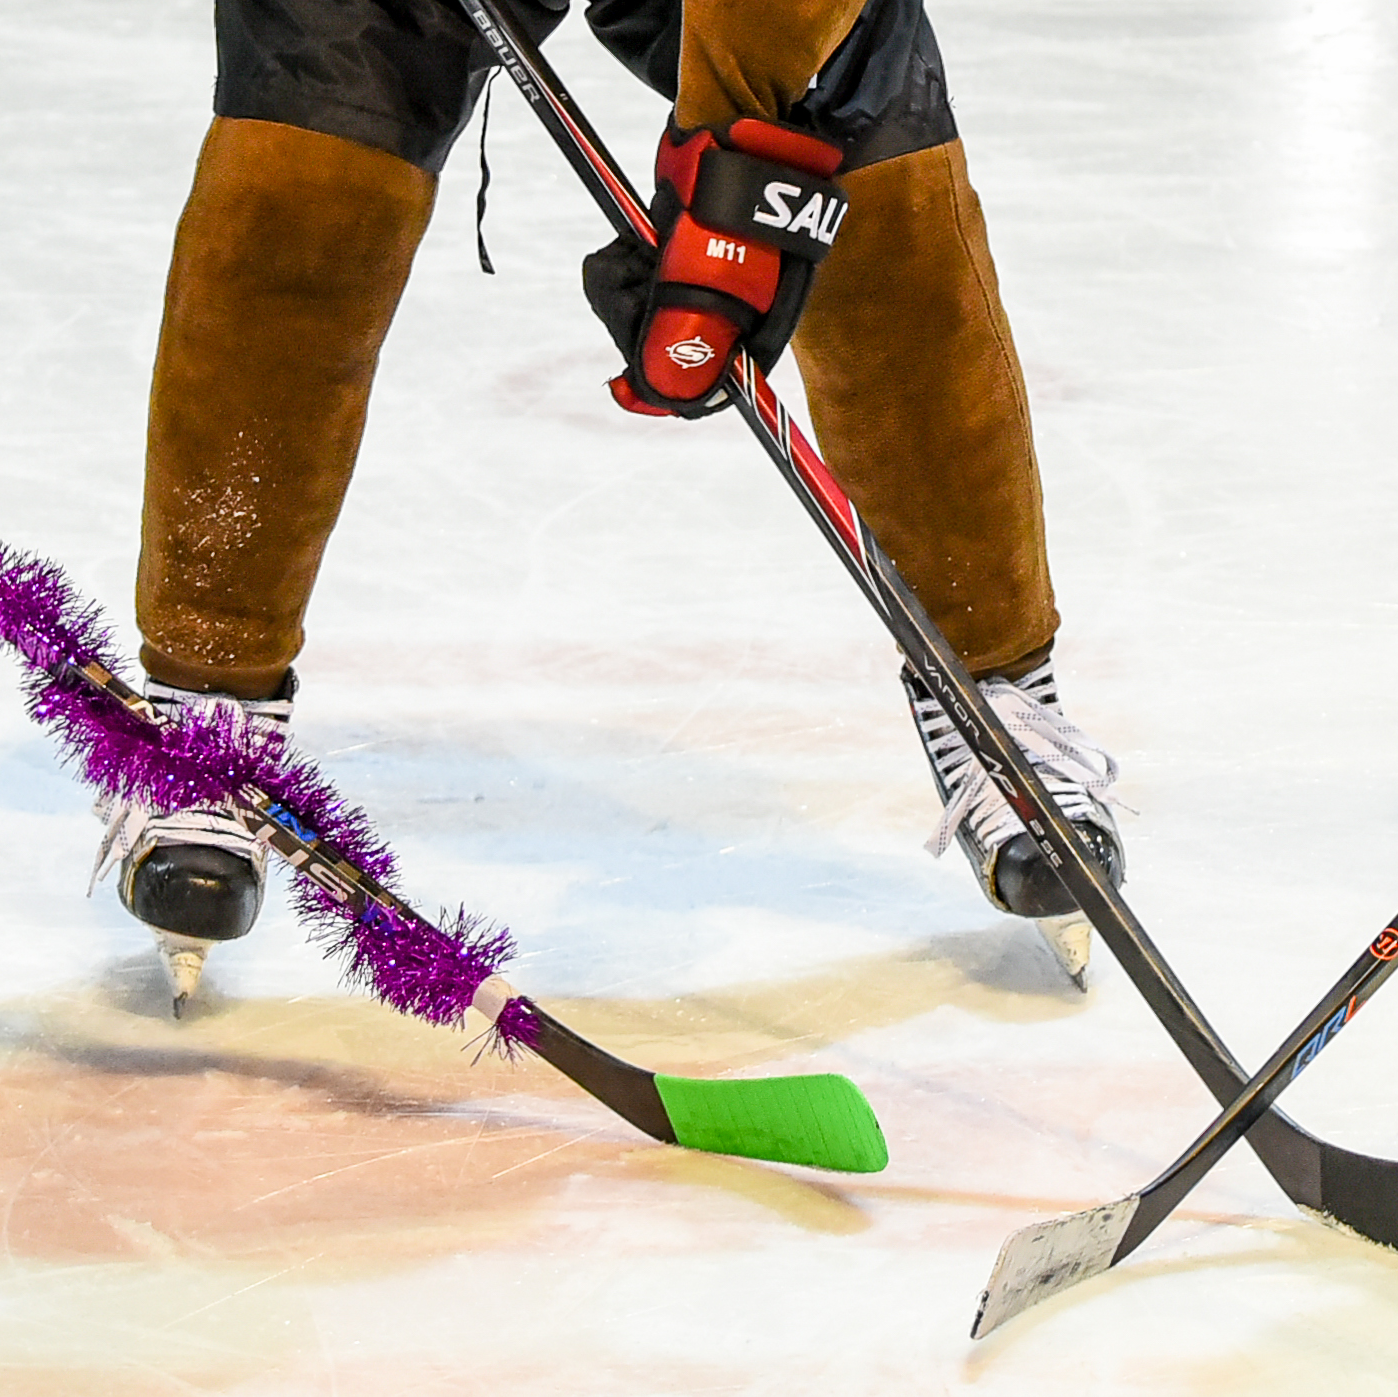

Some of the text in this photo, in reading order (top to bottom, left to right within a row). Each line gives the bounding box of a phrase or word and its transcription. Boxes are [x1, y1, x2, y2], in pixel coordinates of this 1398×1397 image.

[472, 10, 540, 102] BAUER
[706, 238, 746, 264] M11
[922, 654, 980, 738] VAPOR
